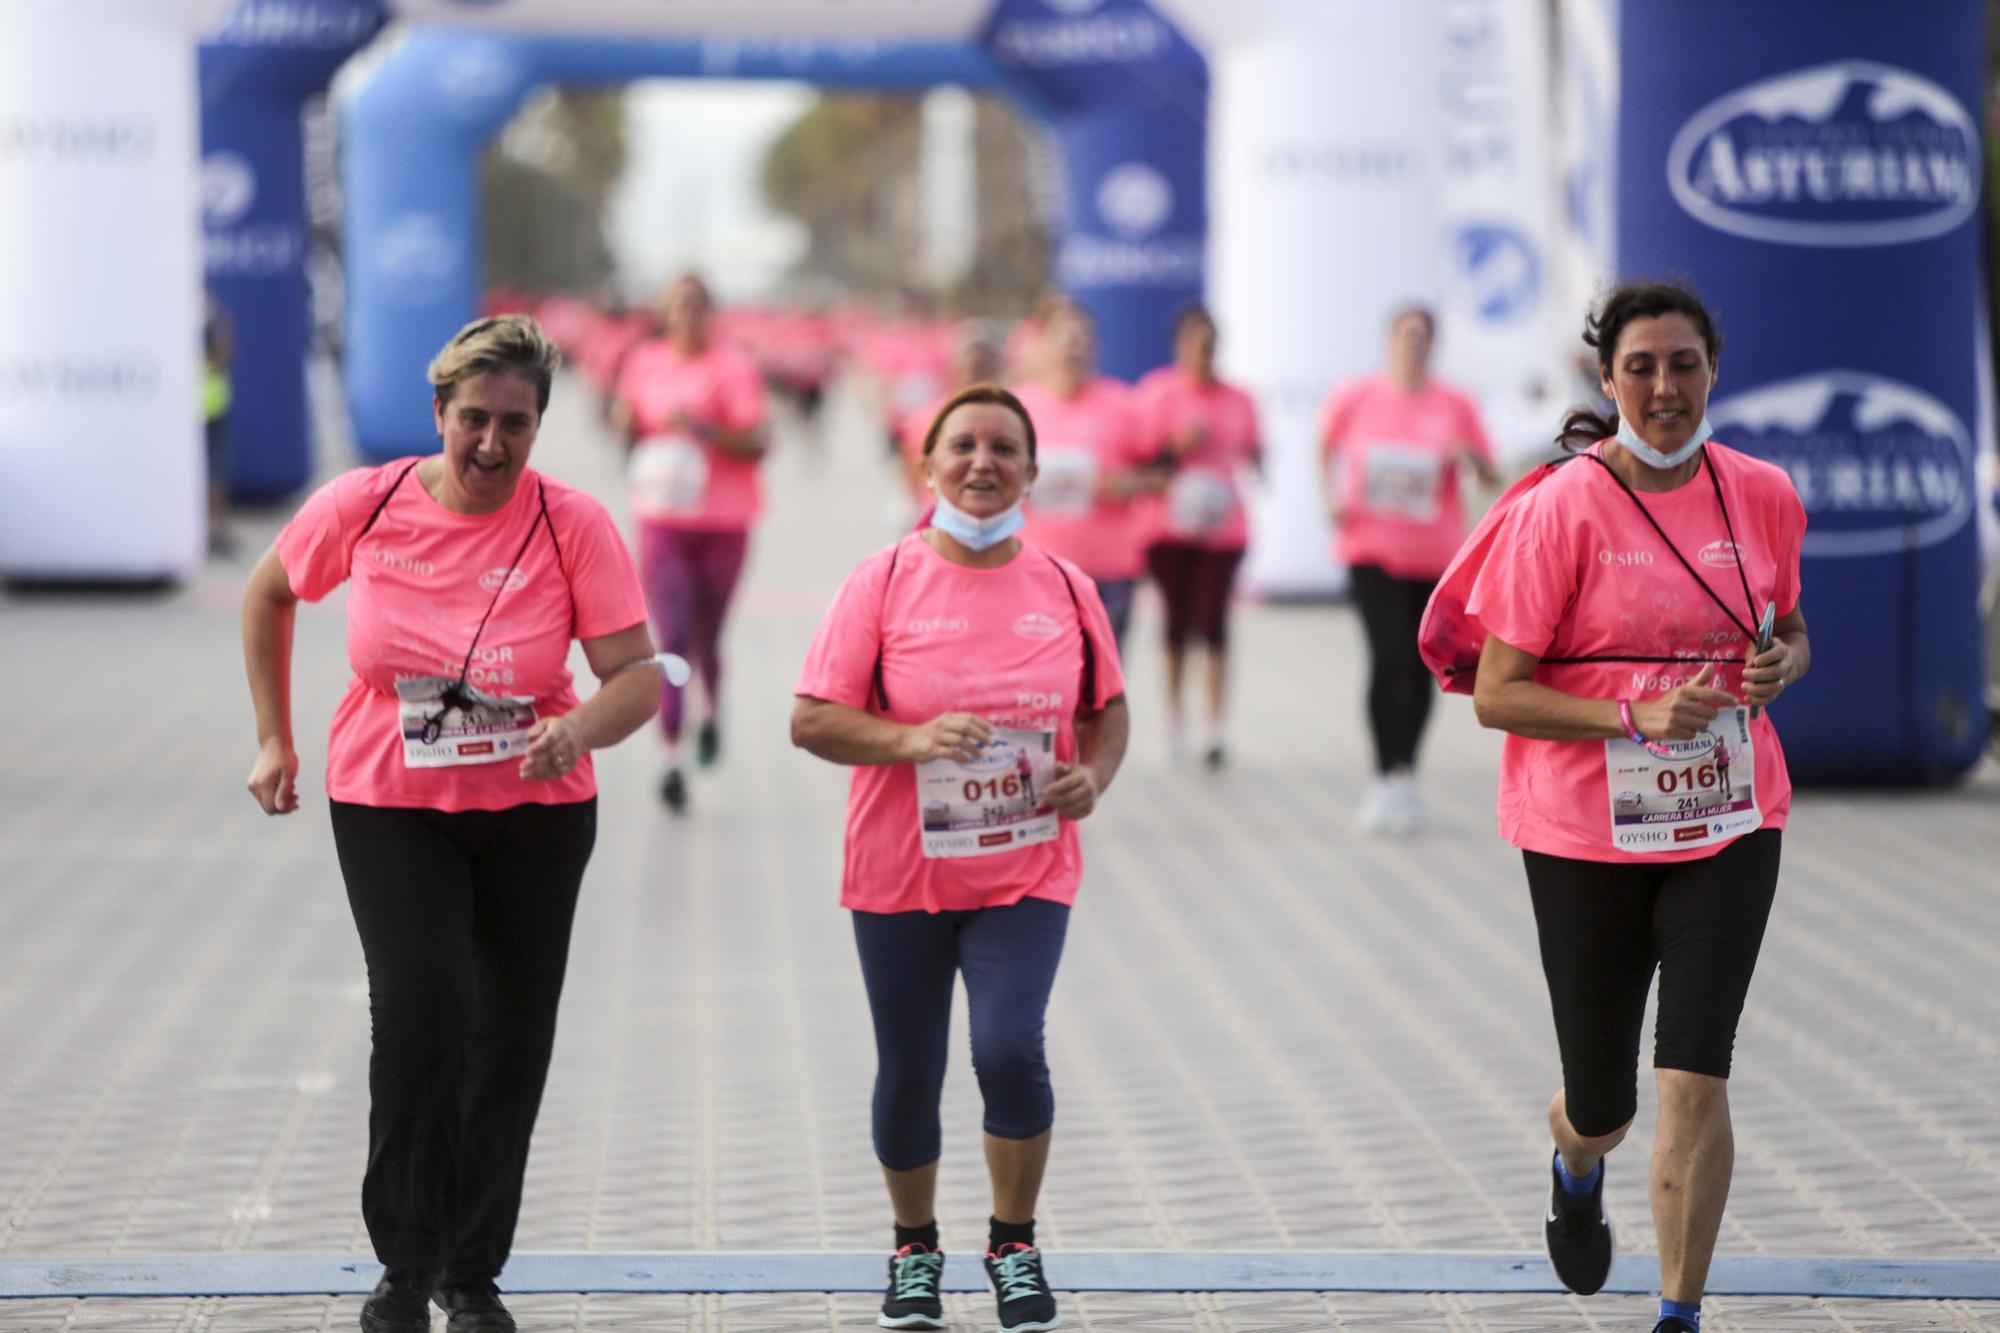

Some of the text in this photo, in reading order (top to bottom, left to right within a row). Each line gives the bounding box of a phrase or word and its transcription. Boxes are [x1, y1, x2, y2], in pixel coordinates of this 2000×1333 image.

[1598, 550, 1654, 566] OSHO
[1703, 630, 1742, 644] POR
[1017, 692, 1063, 710] POR
[1657, 764, 1716, 793] 016
[963, 774, 1019, 803] 016
[1677, 797, 1699, 810] 241
[1641, 804, 1733, 824] CARRERA DE LA MUJER
[1619, 831, 1668, 844] OYSHO
